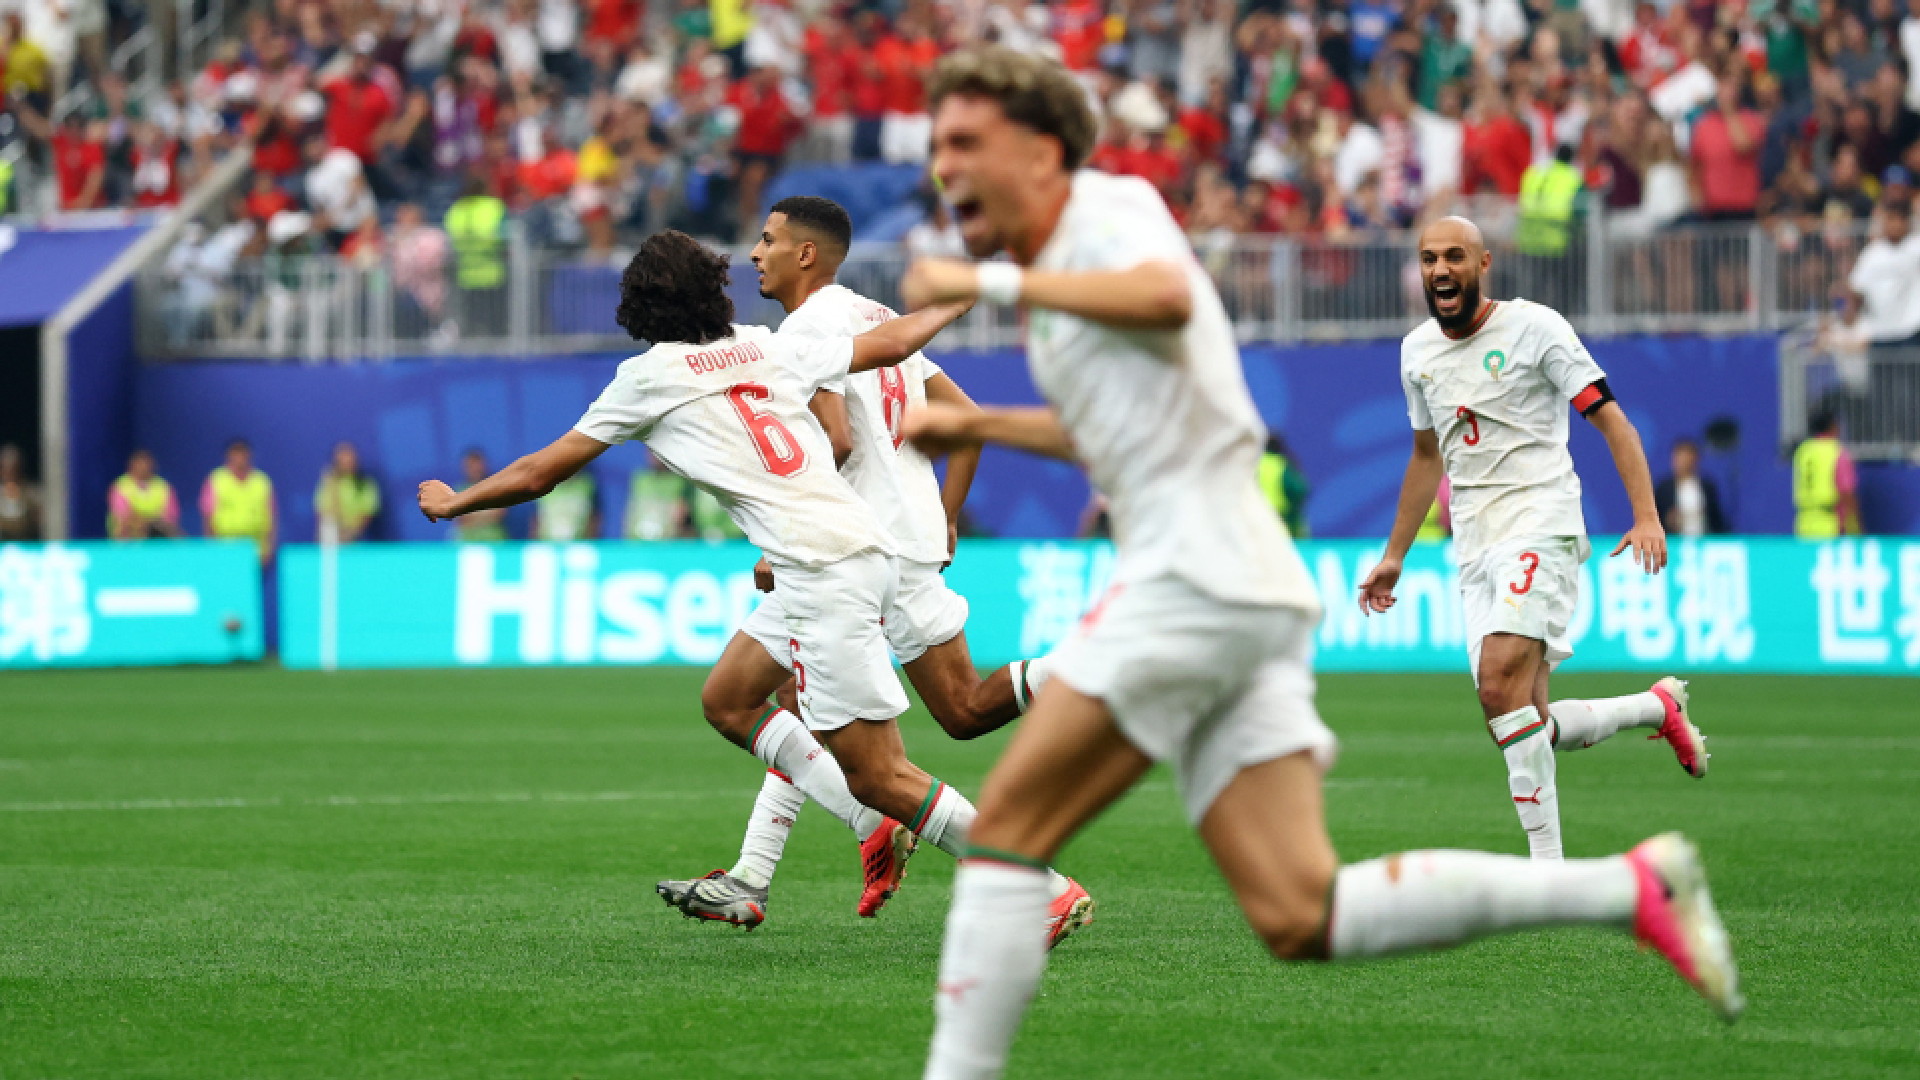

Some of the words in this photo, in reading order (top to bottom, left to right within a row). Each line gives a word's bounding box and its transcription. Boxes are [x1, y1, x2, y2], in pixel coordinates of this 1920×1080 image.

[724, 381, 811, 478] 6
[1456, 405, 1480, 446] 3
[1509, 551, 1540, 594] 3
[1808, 537, 1920, 667] 世
